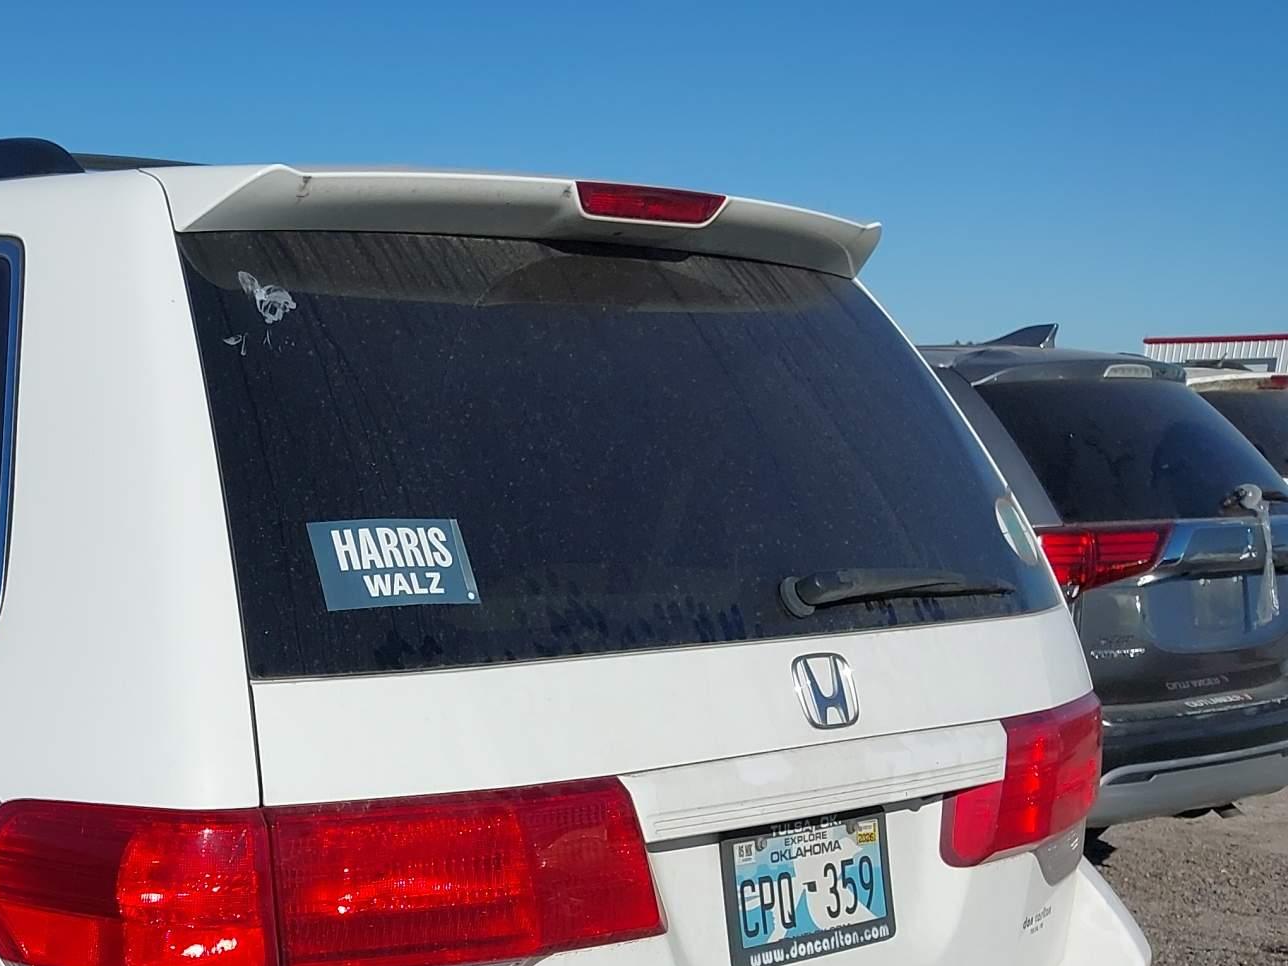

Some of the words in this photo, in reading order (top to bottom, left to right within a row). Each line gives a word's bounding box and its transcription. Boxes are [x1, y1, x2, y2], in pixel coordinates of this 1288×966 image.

[330, 527, 453, 571] HARRIS
[363, 572, 445, 597] WALZ
[784, 831, 828, 846] EXPLORE
[770, 840, 842, 863] OKLAHOMA
